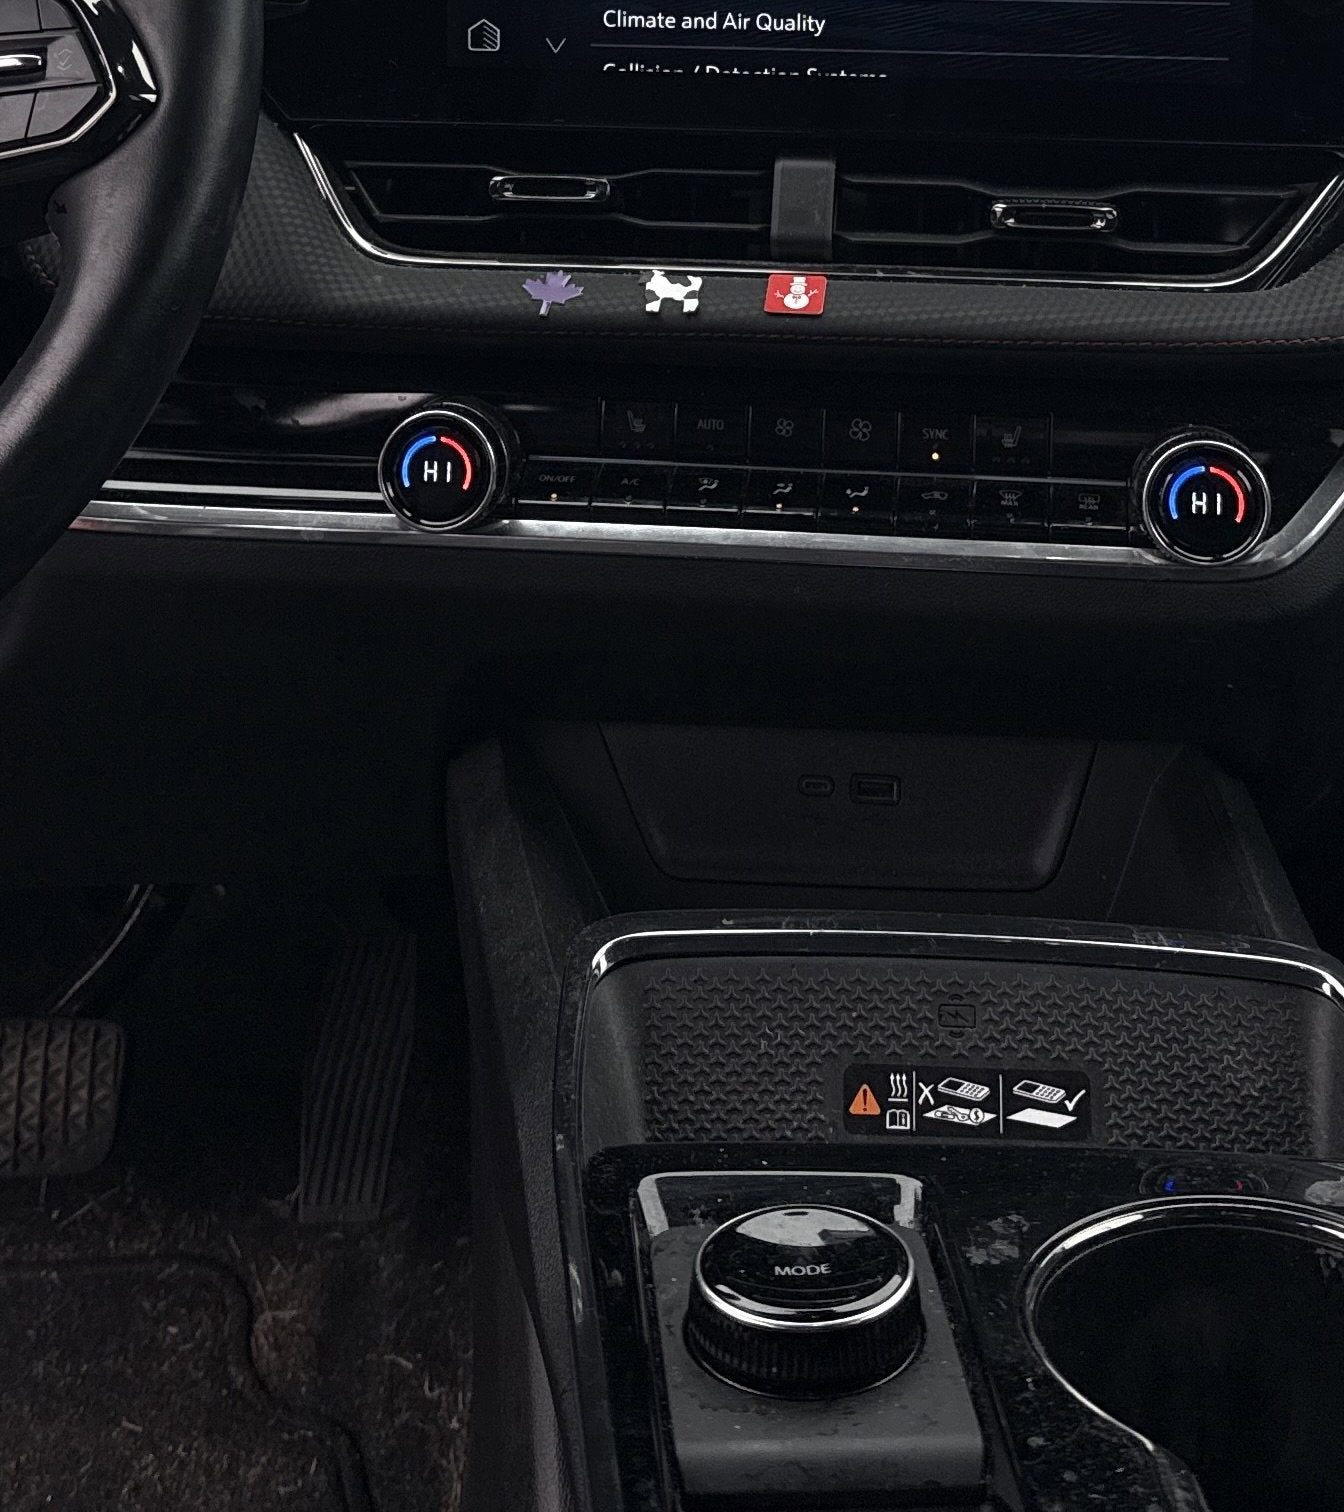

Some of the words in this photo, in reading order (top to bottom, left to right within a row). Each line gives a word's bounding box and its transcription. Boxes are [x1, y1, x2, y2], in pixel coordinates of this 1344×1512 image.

[602, 10, 676, 30] Climate
[681, 11, 717, 30] and
[722, 11, 750, 31] Air
[756, 12, 826, 37] Quality
[697, 418, 725, 431] AUTO
[921, 428, 950, 441] SYNC
[538, 473, 576, 484] ON/OFF
[620, 477, 641, 488] A/C
[774, 1263, 832, 1276] MODE
